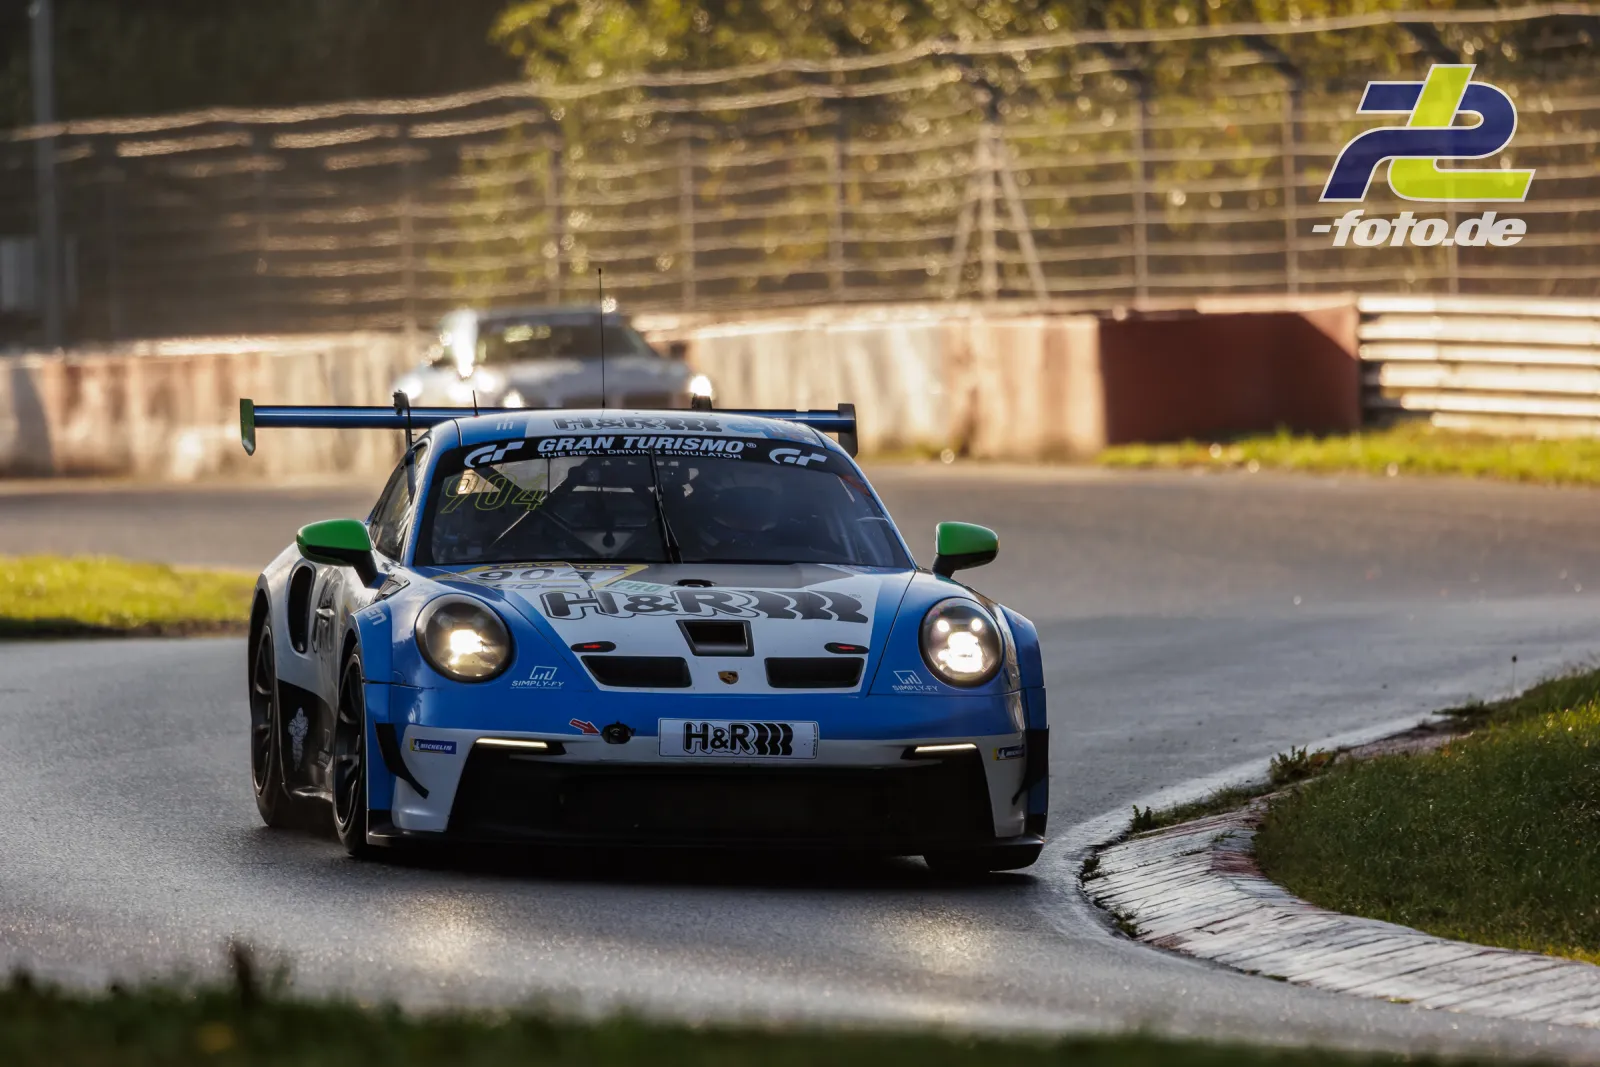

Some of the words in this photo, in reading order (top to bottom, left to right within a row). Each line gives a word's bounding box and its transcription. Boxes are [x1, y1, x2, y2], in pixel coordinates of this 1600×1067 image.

[537, 435, 615, 453] GRAN
[665, 449, 742, 460] SIMULATOR
[440, 472, 545, 514] 904
[478, 568, 597, 582] 904
[611, 580, 665, 593] PRO
[683, 721, 757, 756] H&R
[419, 743, 453, 751] MICHELIN
